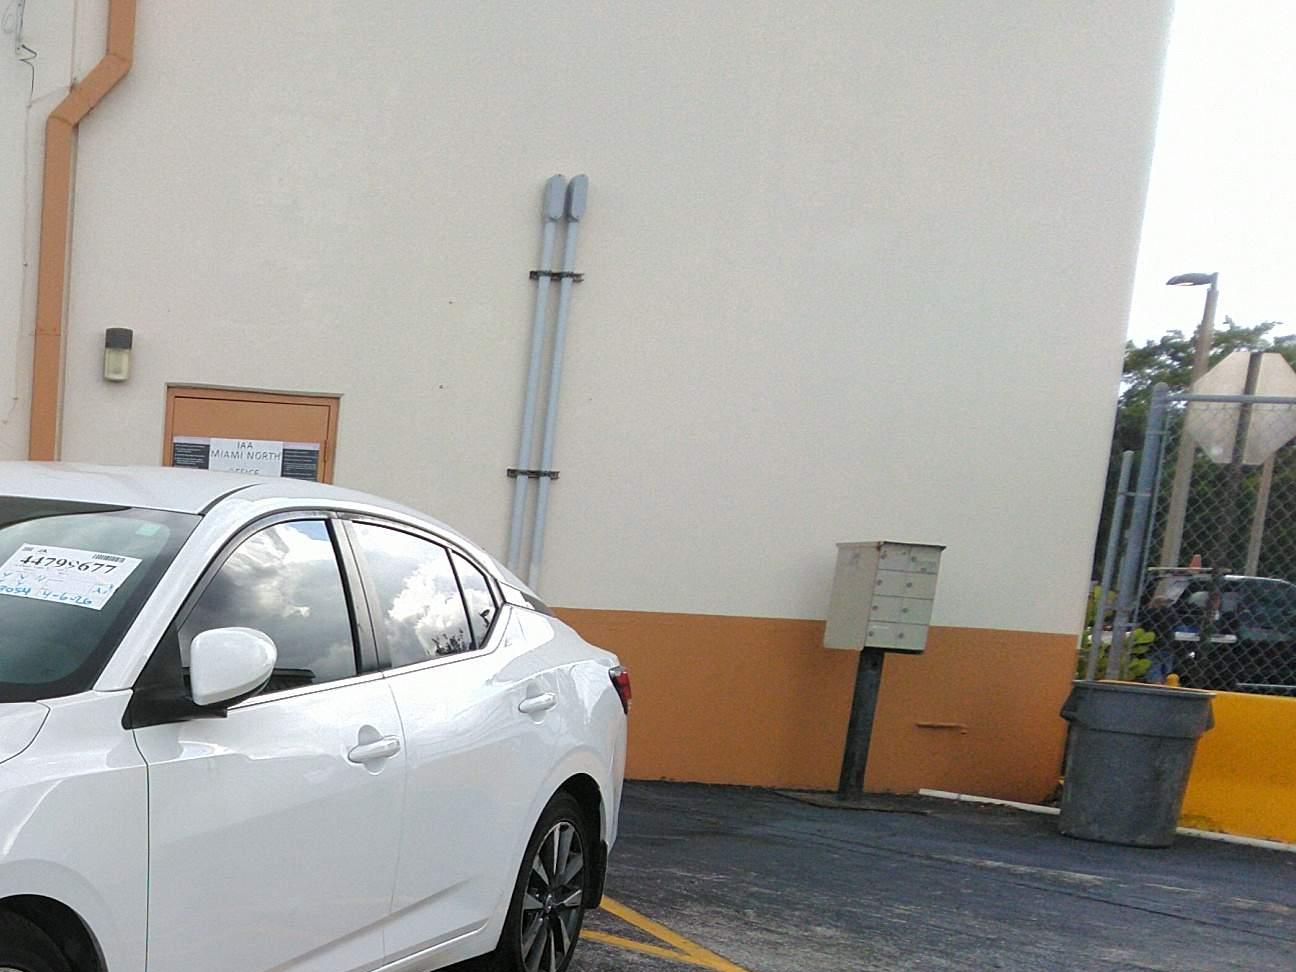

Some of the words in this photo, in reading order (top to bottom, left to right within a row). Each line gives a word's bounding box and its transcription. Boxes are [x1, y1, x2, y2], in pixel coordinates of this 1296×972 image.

[237, 441, 253, 449] IAA
[211, 449, 244, 460] MIAMI
[246, 451, 281, 461] NORTH
